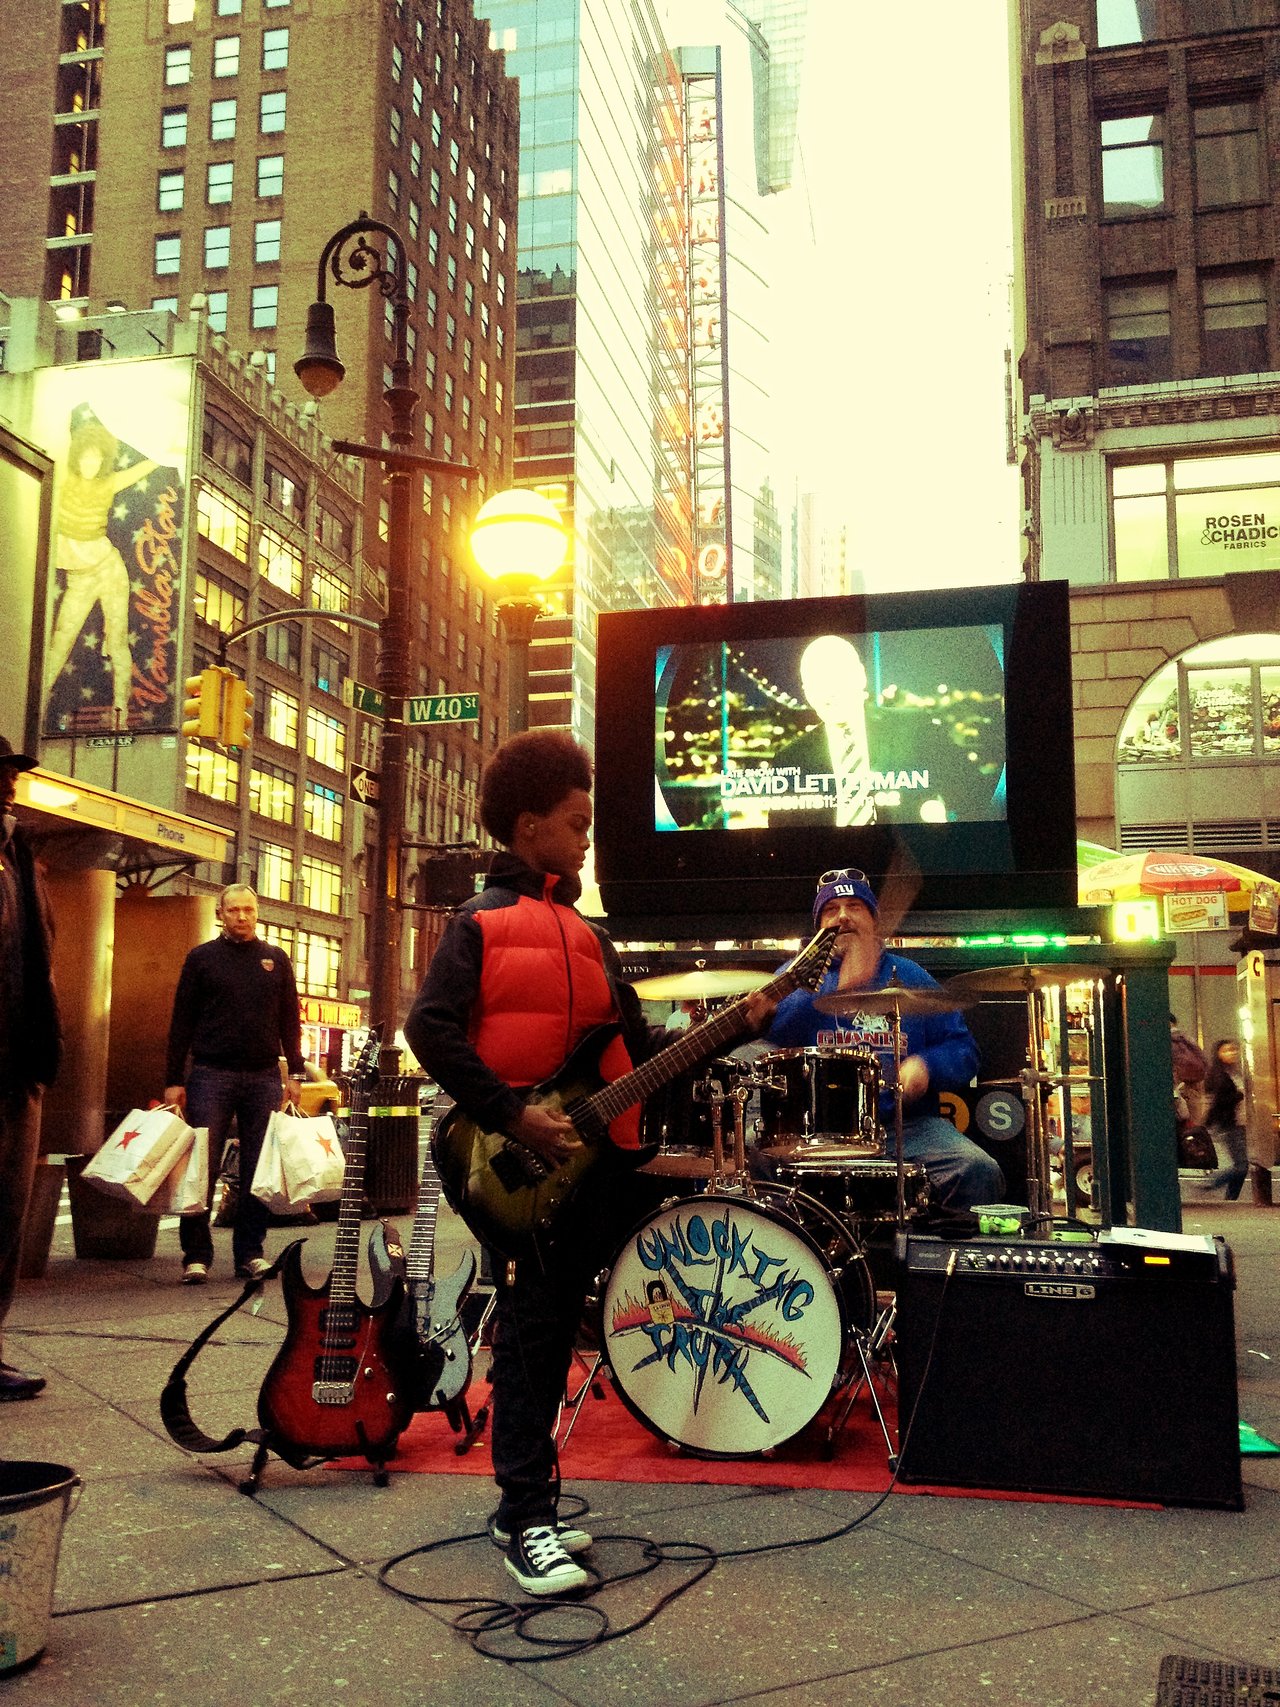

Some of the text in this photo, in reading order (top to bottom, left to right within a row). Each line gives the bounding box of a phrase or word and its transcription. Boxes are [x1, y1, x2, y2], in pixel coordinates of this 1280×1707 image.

[1205, 513, 1265, 529] ROSEN
[1224, 540, 1267, 550] FABRICS
[357, 686, 366, 708] 7
[413, 696, 477, 721] W 40 St
[776, 766, 801, 776] WITH
[358, 778, 376, 794] ONE
[720, 769, 930, 797] DAVID LETMAN
[157, 823, 186, 844] Phone
[1171, 896, 1218, 906] HOT DOG
[817, 1029, 909, 1050] GIANTS
[988, 1101, 1012, 1131] S
[636, 1213, 815, 1322] UNLOCKING
[1028, 1285, 1074, 1295] LINE
[640, 1321, 750, 1393] TRUTH
